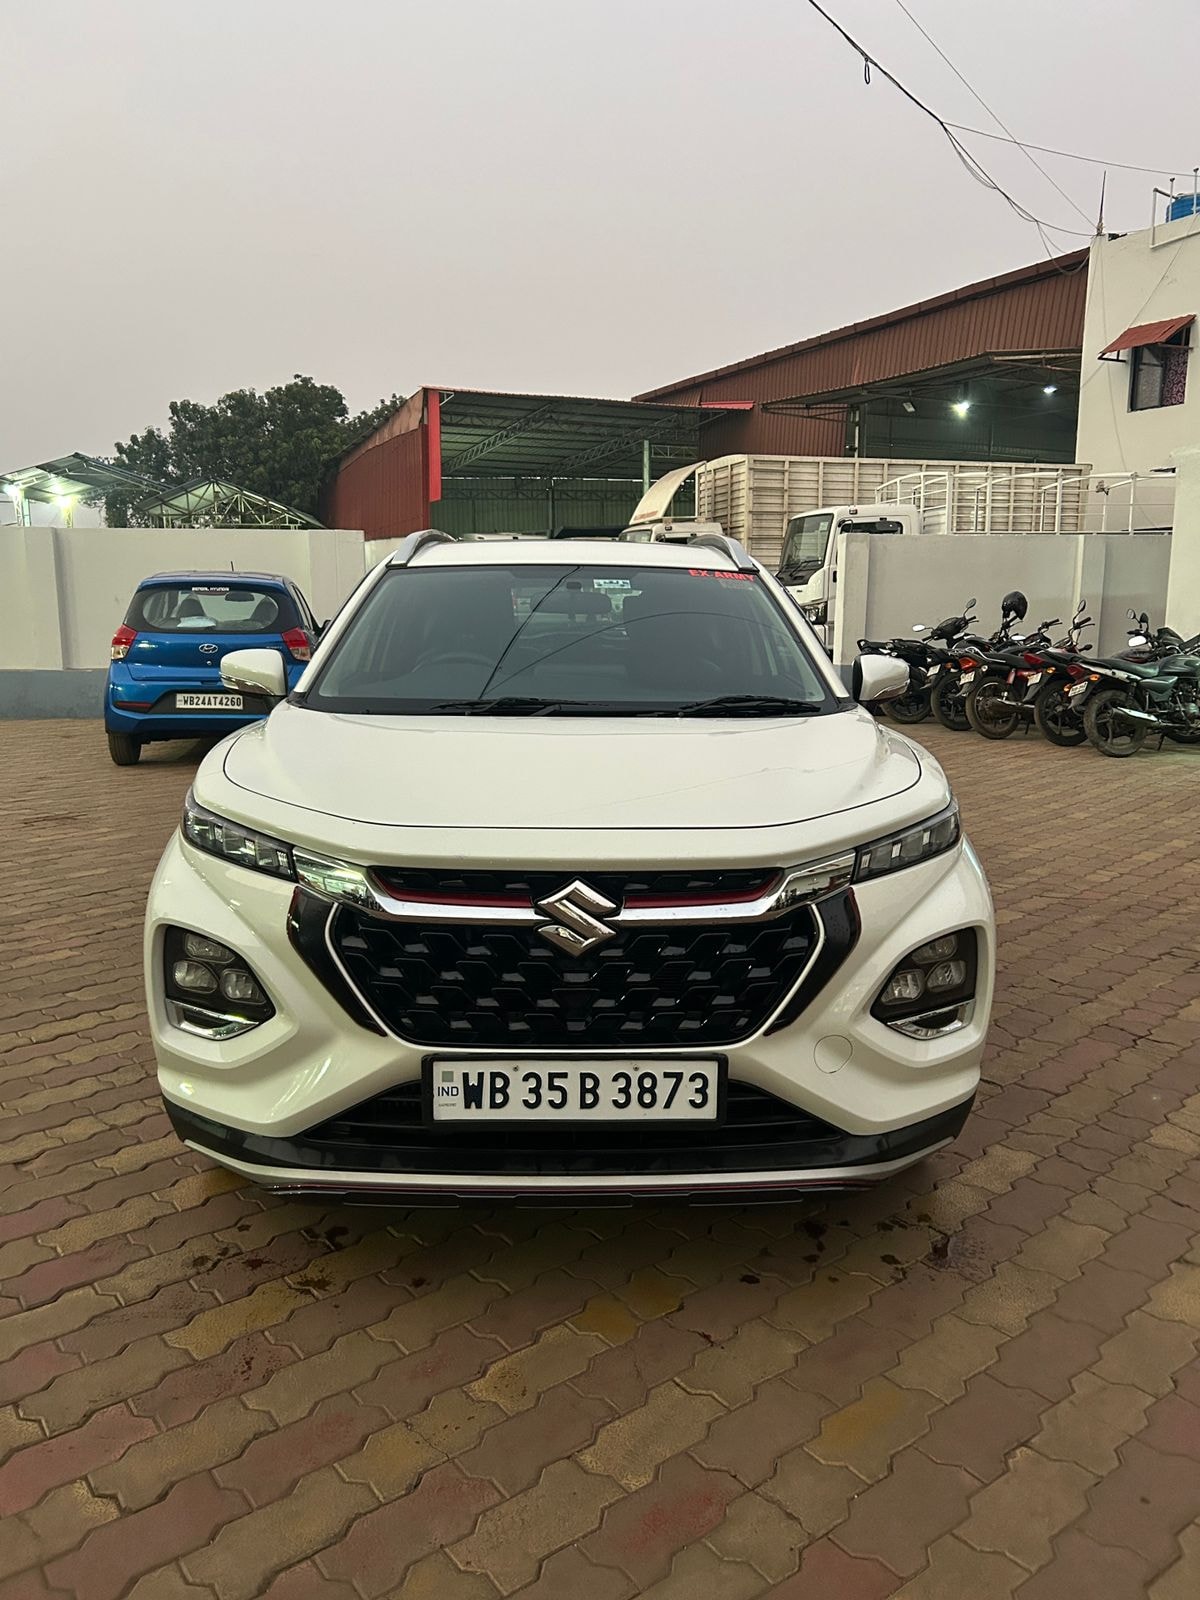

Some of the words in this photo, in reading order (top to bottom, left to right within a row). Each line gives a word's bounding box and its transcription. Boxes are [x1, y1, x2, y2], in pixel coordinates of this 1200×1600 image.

[183, 696, 242, 707] WB24AT4260
[437, 1086, 459, 1097] IND
[462, 1072, 510, 1109] WB
[521, 1072, 568, 1109] 35
[579, 1072, 600, 1109] B
[611, 1072, 709, 1109] 3873
